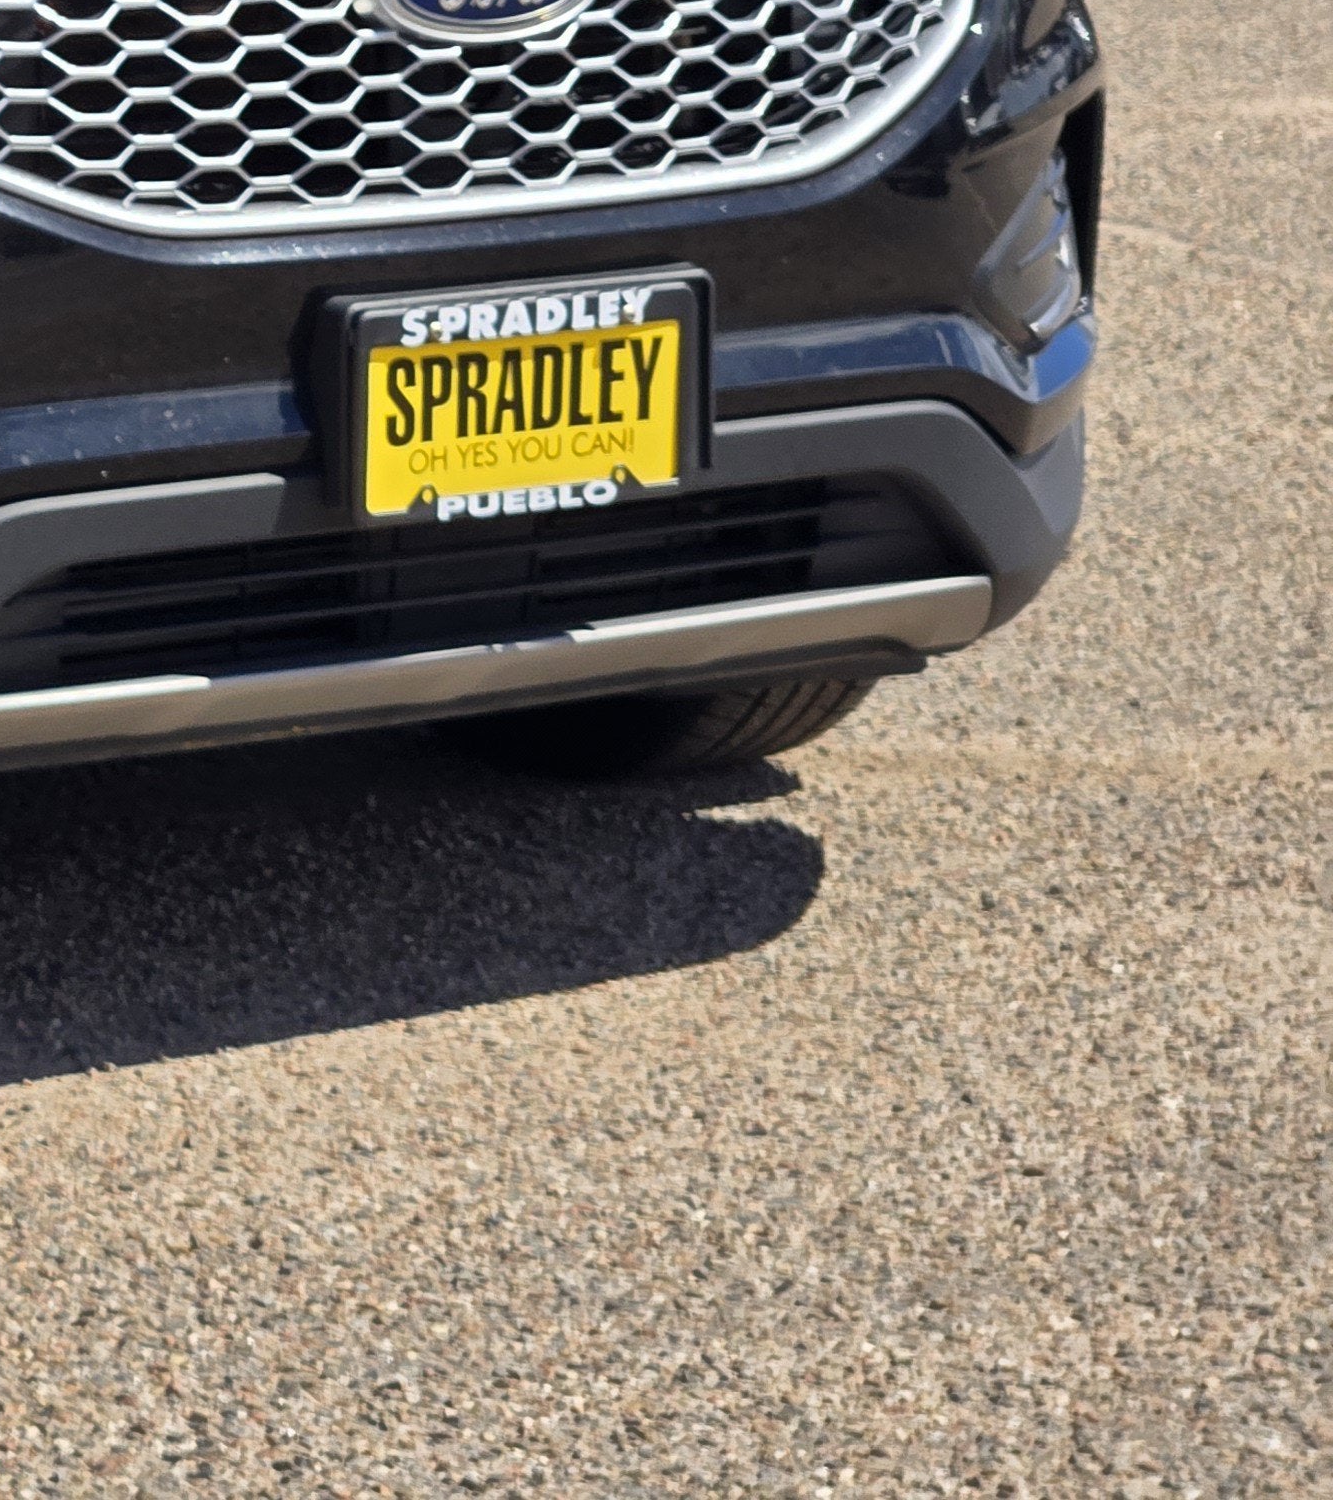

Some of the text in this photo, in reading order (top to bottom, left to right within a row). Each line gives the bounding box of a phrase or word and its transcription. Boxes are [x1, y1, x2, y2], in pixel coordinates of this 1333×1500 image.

[400, 287, 652, 347] SPRADLEY
[385, 336, 663, 447] SPRADLEY
[408, 426, 635, 475] OH YES YOU CAN!
[436, 478, 618, 522] PUEBLO
